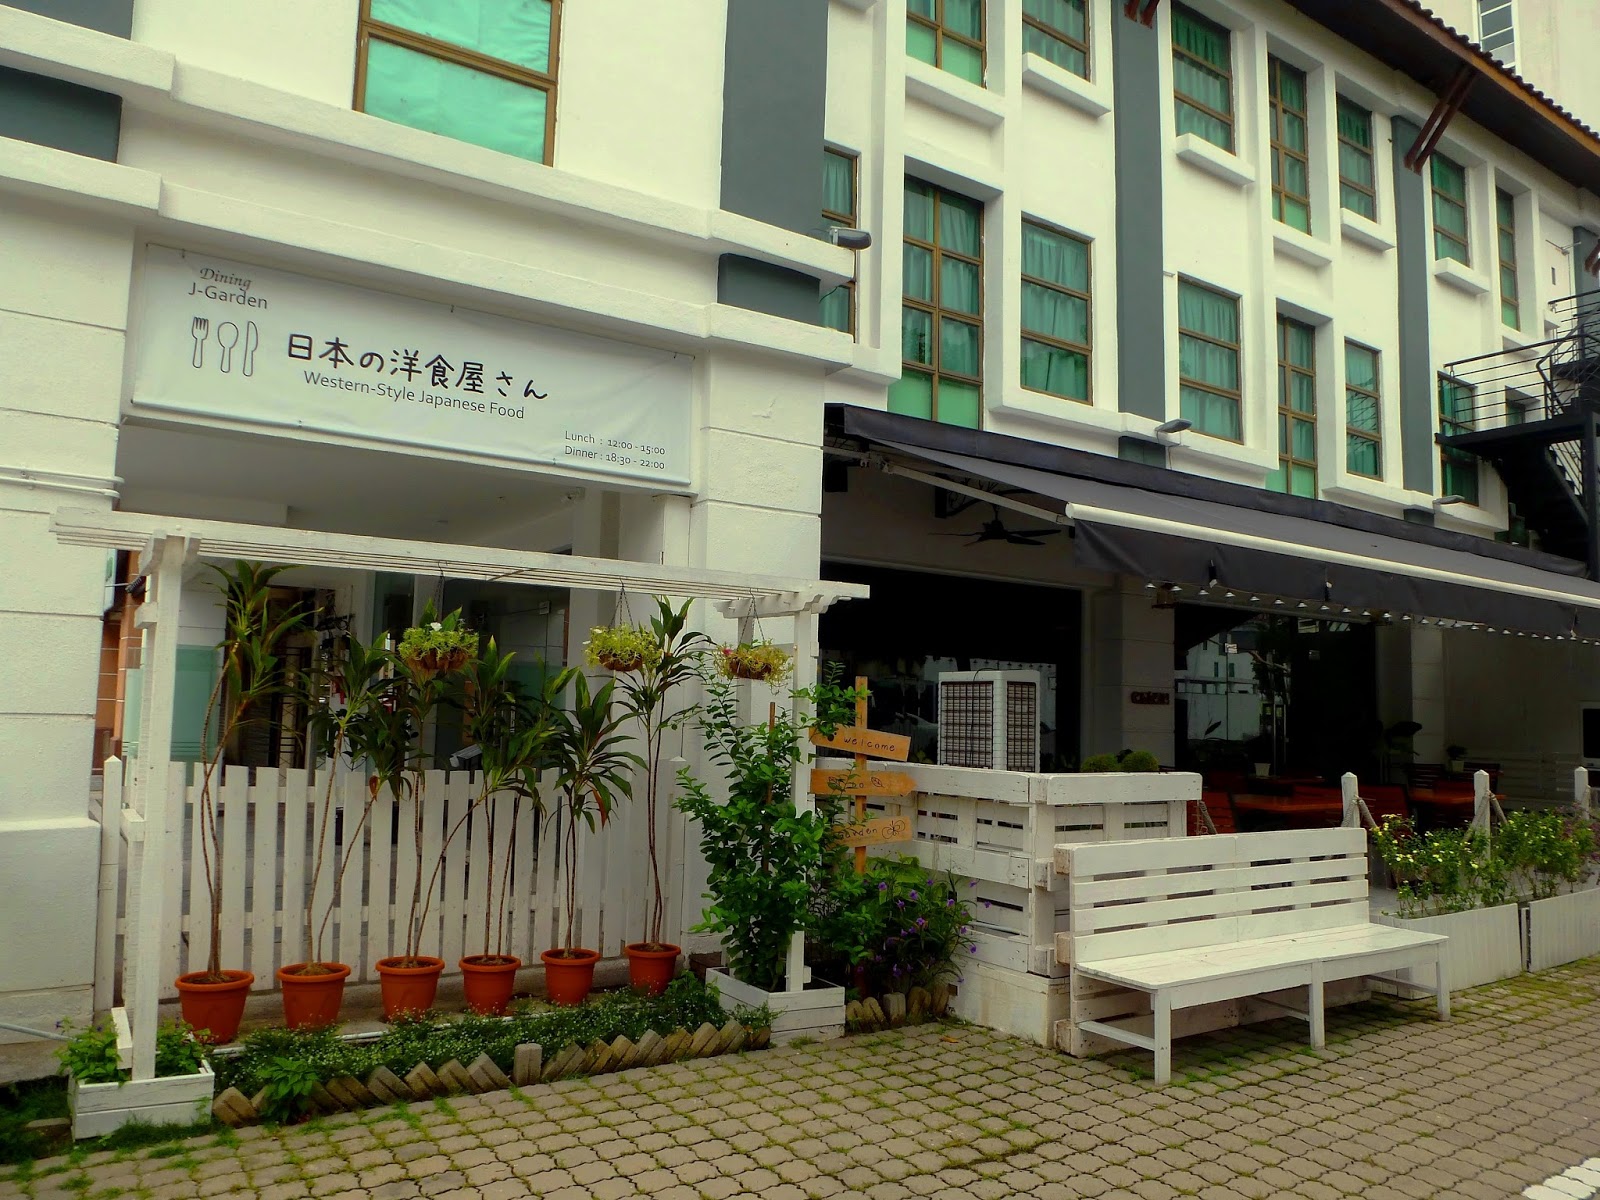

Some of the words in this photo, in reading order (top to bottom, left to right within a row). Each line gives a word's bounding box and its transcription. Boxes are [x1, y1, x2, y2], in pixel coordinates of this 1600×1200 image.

[200, 267, 252, 290] Dining
[189, 282, 268, 310] J-Garden
[288, 333, 548, 400] 日本の洋食屋さん
[303, 369, 416, 403] Western-Style
[418, 390, 486, 414] Japanese
[489, 402, 524, 420] Food
[564, 430, 595, 444] Lunch
[607, 439, 633, 450] 12:00
[640, 445, 666, 455] 15:00
[564, 445, 598, 459] Dinner
[605, 452, 631, 466] 18:30
[640, 459, 665, 470] 22:00
[843, 736, 896, 752] welcome
